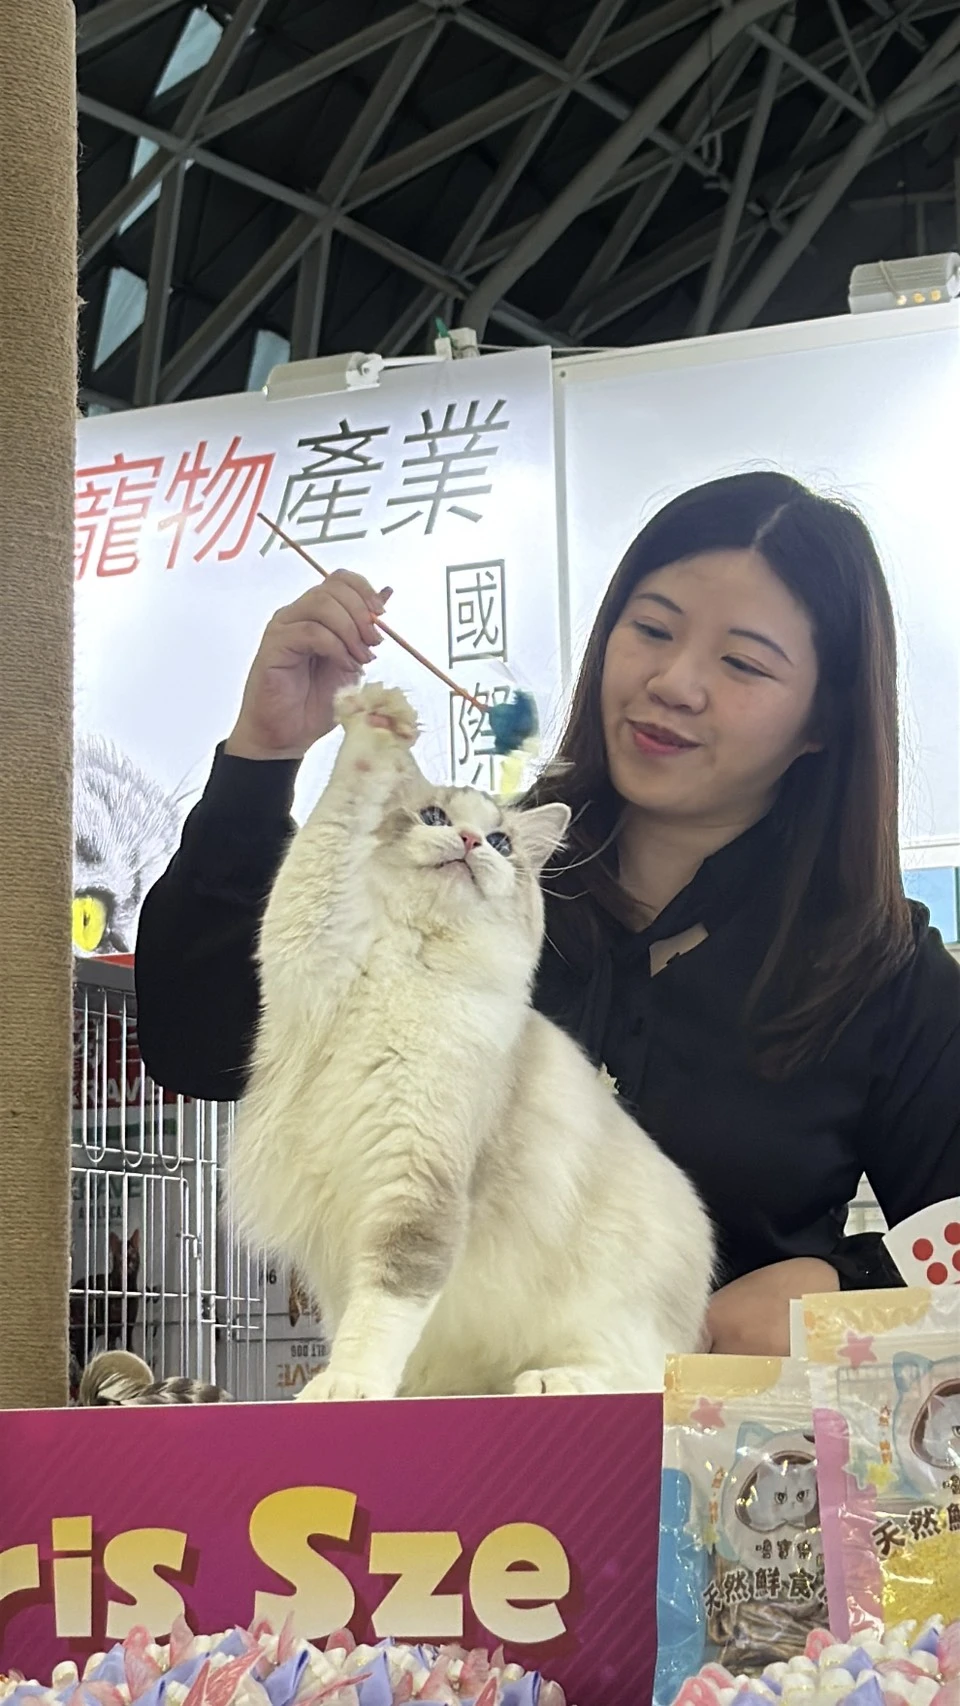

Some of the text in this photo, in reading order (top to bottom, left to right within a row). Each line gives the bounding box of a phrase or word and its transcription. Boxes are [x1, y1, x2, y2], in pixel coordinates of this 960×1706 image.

[74, 398, 511, 580] 寵物產業
[249, 1486, 571, 1643] Sze
